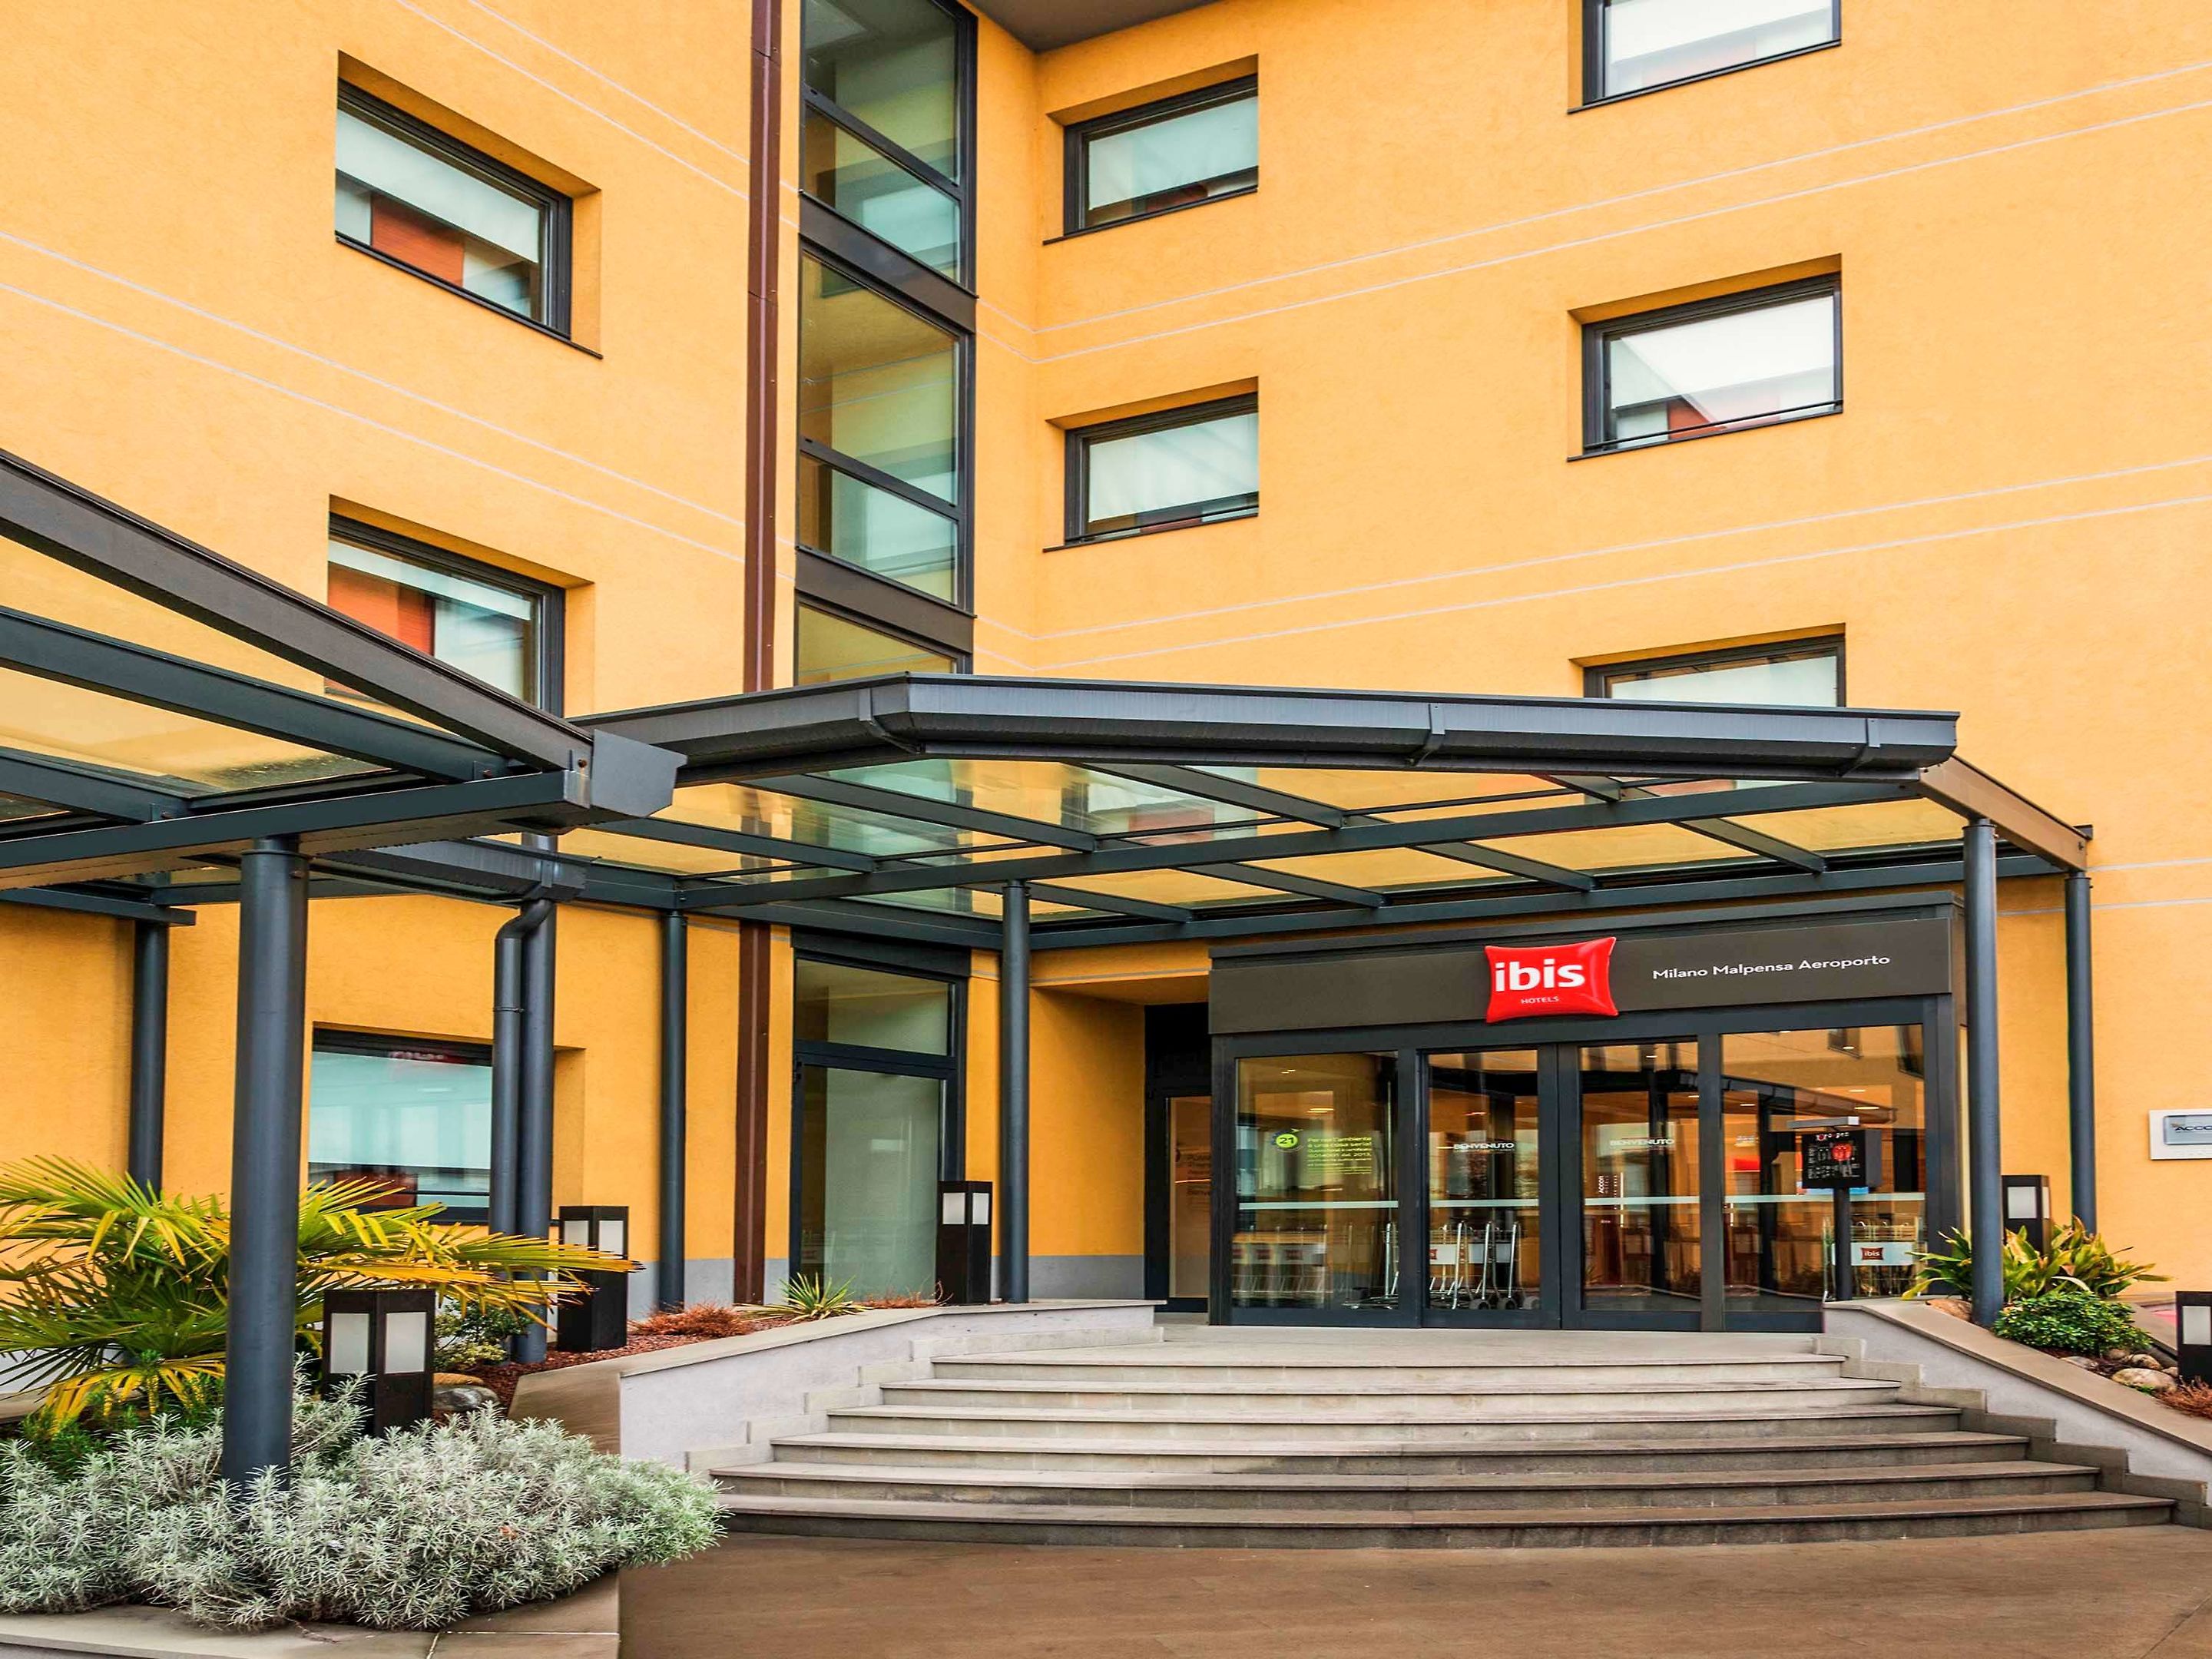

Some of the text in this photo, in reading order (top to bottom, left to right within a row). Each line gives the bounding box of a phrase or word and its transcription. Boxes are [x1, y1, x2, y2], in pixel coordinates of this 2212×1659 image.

[1495, 958, 1585, 992] ibis
[1653, 955, 1890, 979] Milano Malpensa Aeroporto
[1521, 995, 1559, 1005] HOTELS
